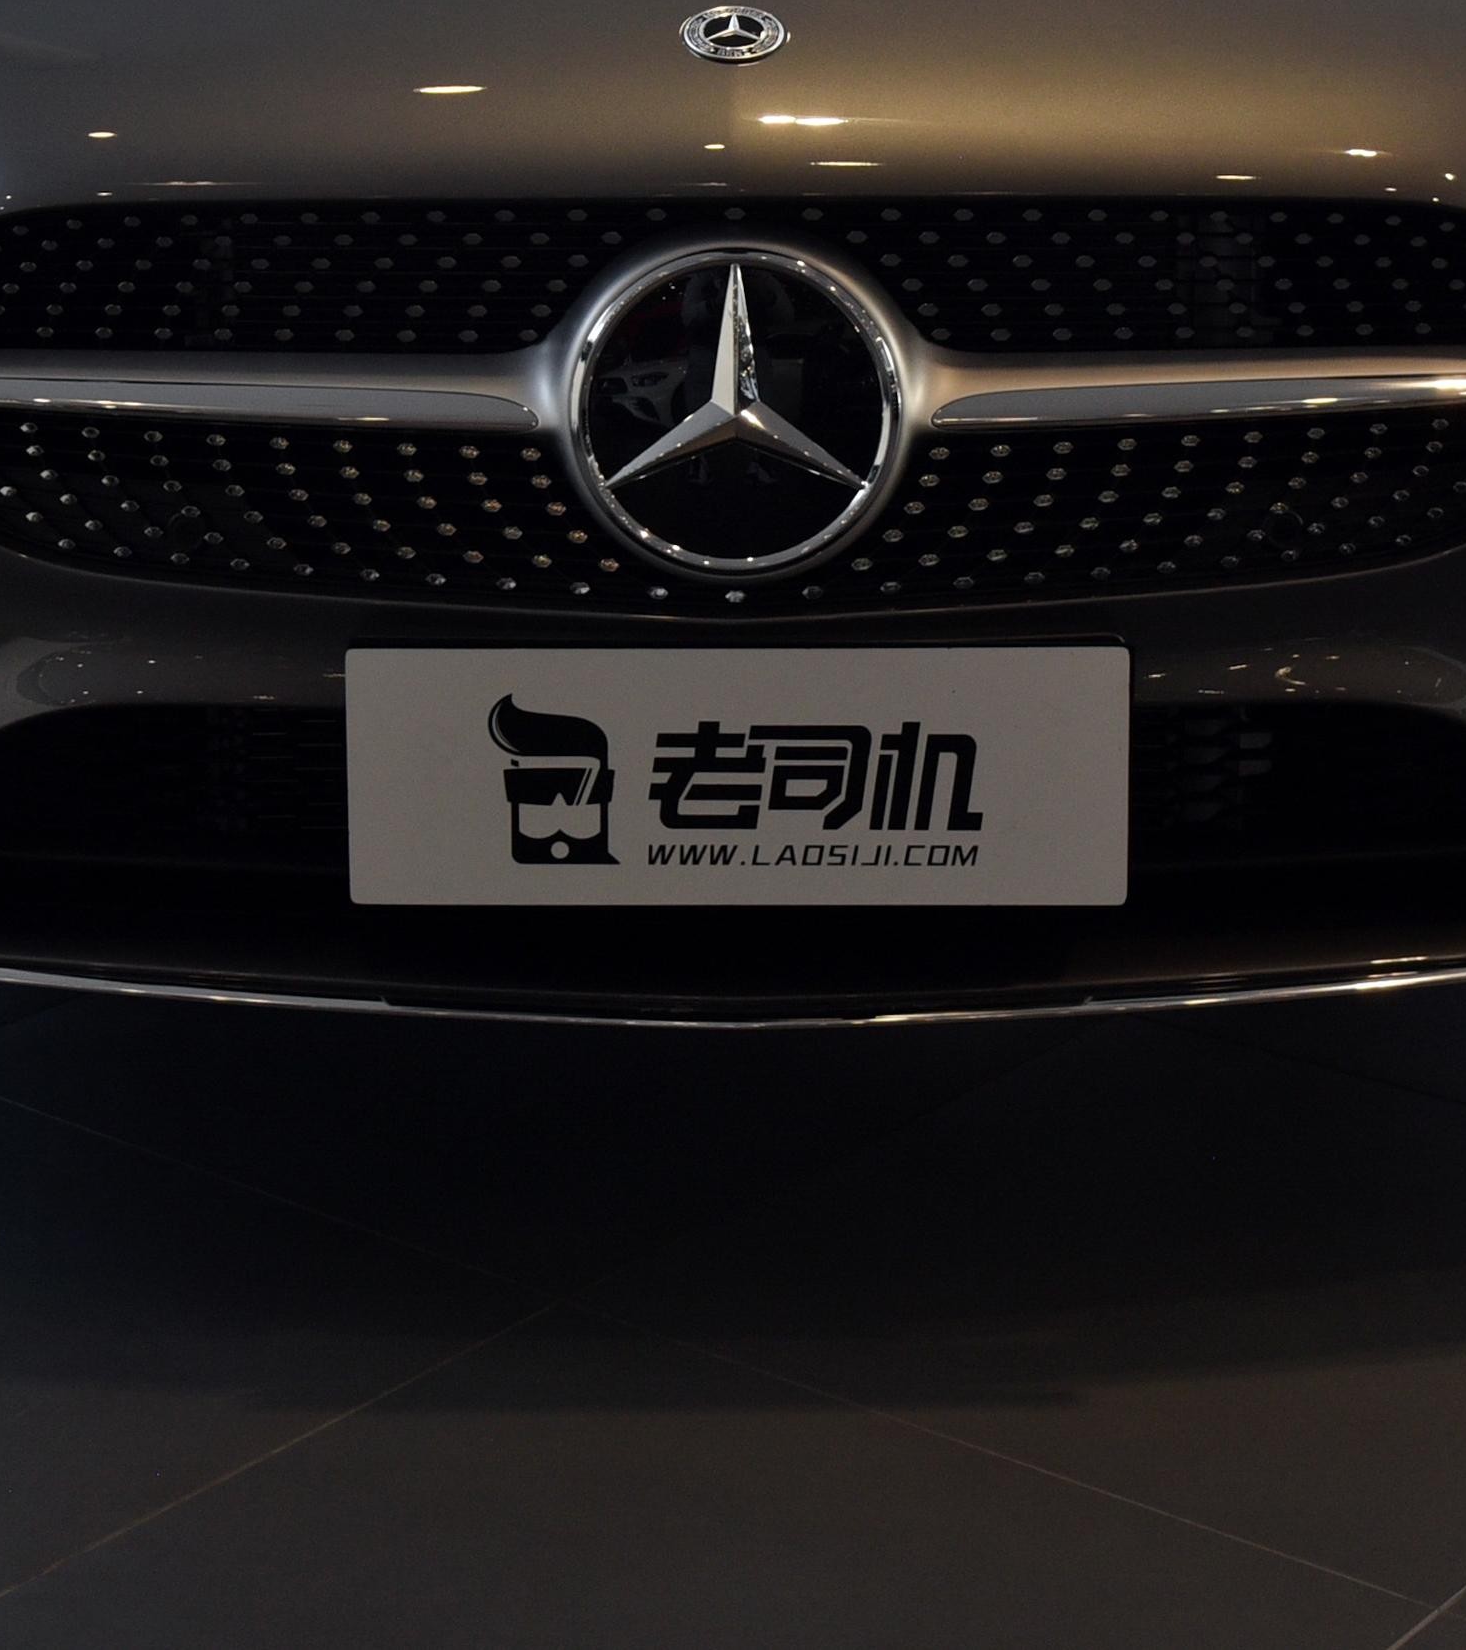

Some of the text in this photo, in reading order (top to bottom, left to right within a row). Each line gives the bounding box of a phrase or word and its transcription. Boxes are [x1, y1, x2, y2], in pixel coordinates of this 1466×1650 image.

[648, 721, 983, 831] 老司机
[647, 844, 979, 867] WWW.LAOSIJI.COM
